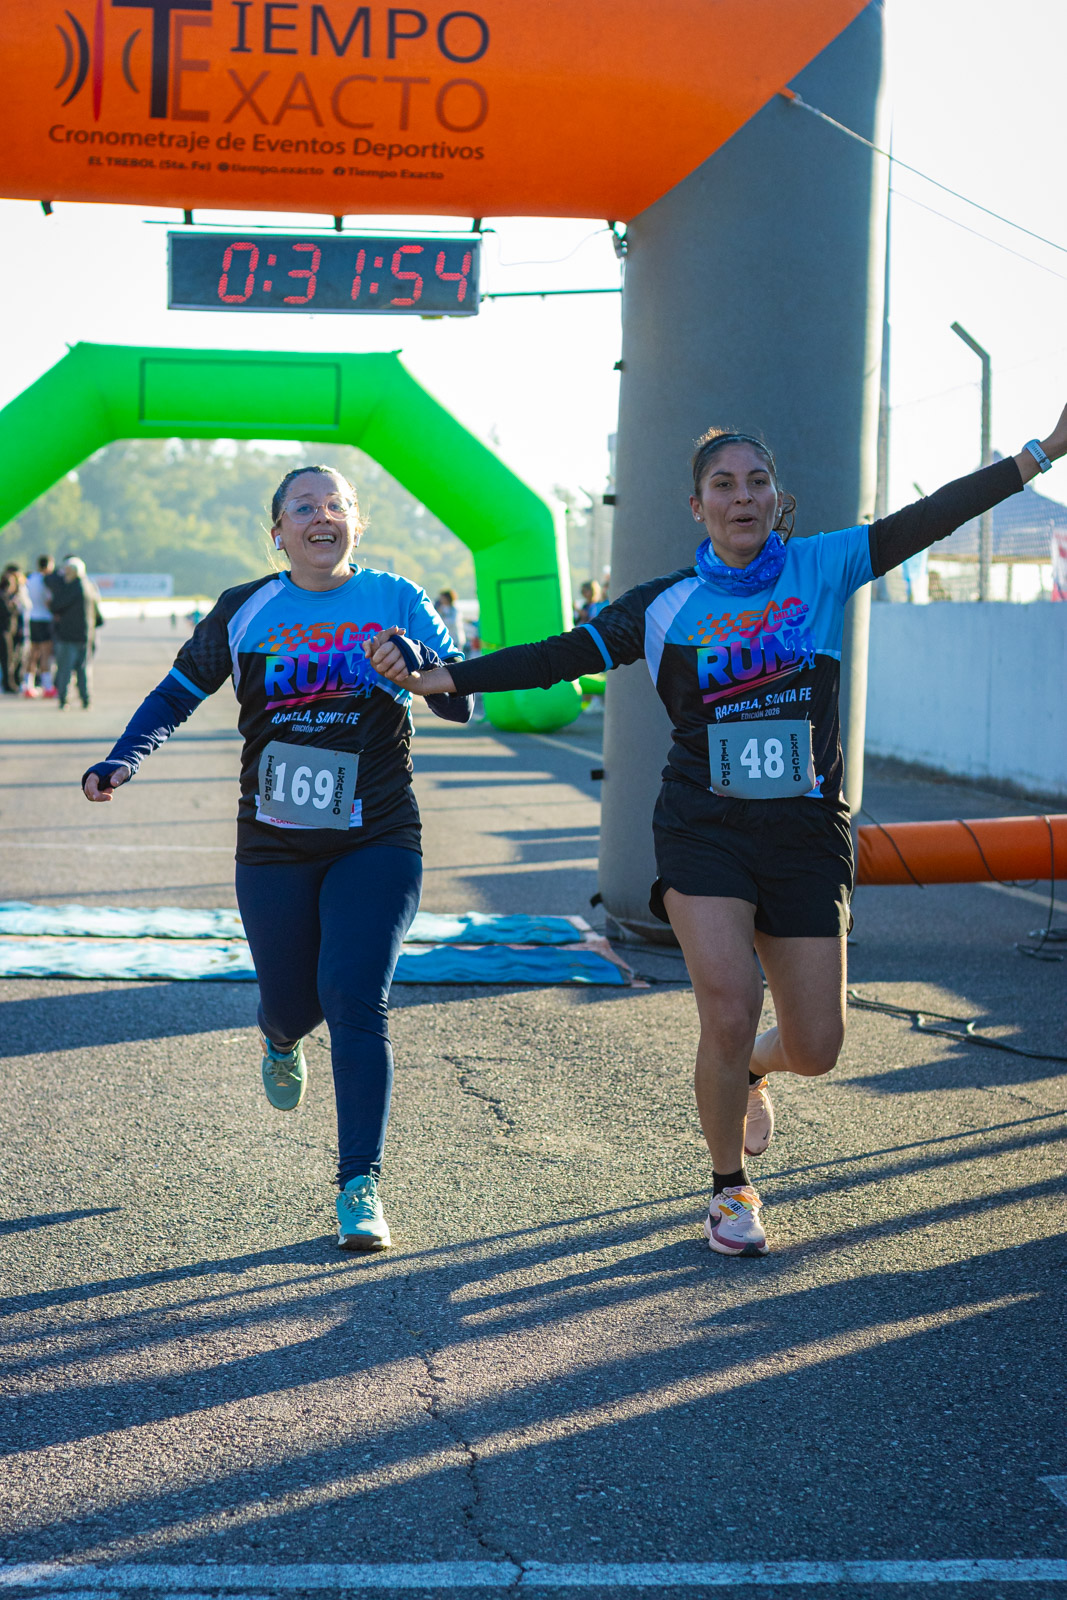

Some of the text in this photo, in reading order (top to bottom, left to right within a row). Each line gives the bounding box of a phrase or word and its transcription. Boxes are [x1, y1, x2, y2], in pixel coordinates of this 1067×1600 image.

[49, 124, 485, 160] Cronometraje de Eventos Deportivos
[88, 156, 103, 166] EL
[348, 167, 397, 178] Tiempo
[401, 169, 444, 180] Exacto
[218, 242, 472, 306] 0:31:54
[738, 597, 803, 638] 500
[773, 604, 809, 622] MILLAS
[349, 633, 371, 642] MILL
[265, 653, 364, 697] RUN
[697, 627, 801, 690] RUN
[271, 710, 312, 724] RAAELA,
[346, 712, 360, 724] FE
[714, 687, 812, 720] RAFAELA, SANTA FE
[765, 707, 780, 717] 2026
[720, 738, 731, 786] TIEMPO
[740, 738, 784, 778] 48
[790, 733, 801, 782] EXACTO
[265, 755, 275, 801] TIEMPO
[273, 762, 334, 809] 169
[332, 766, 346, 815] EXACTO
[730, 1203, 742, 1212] 48
